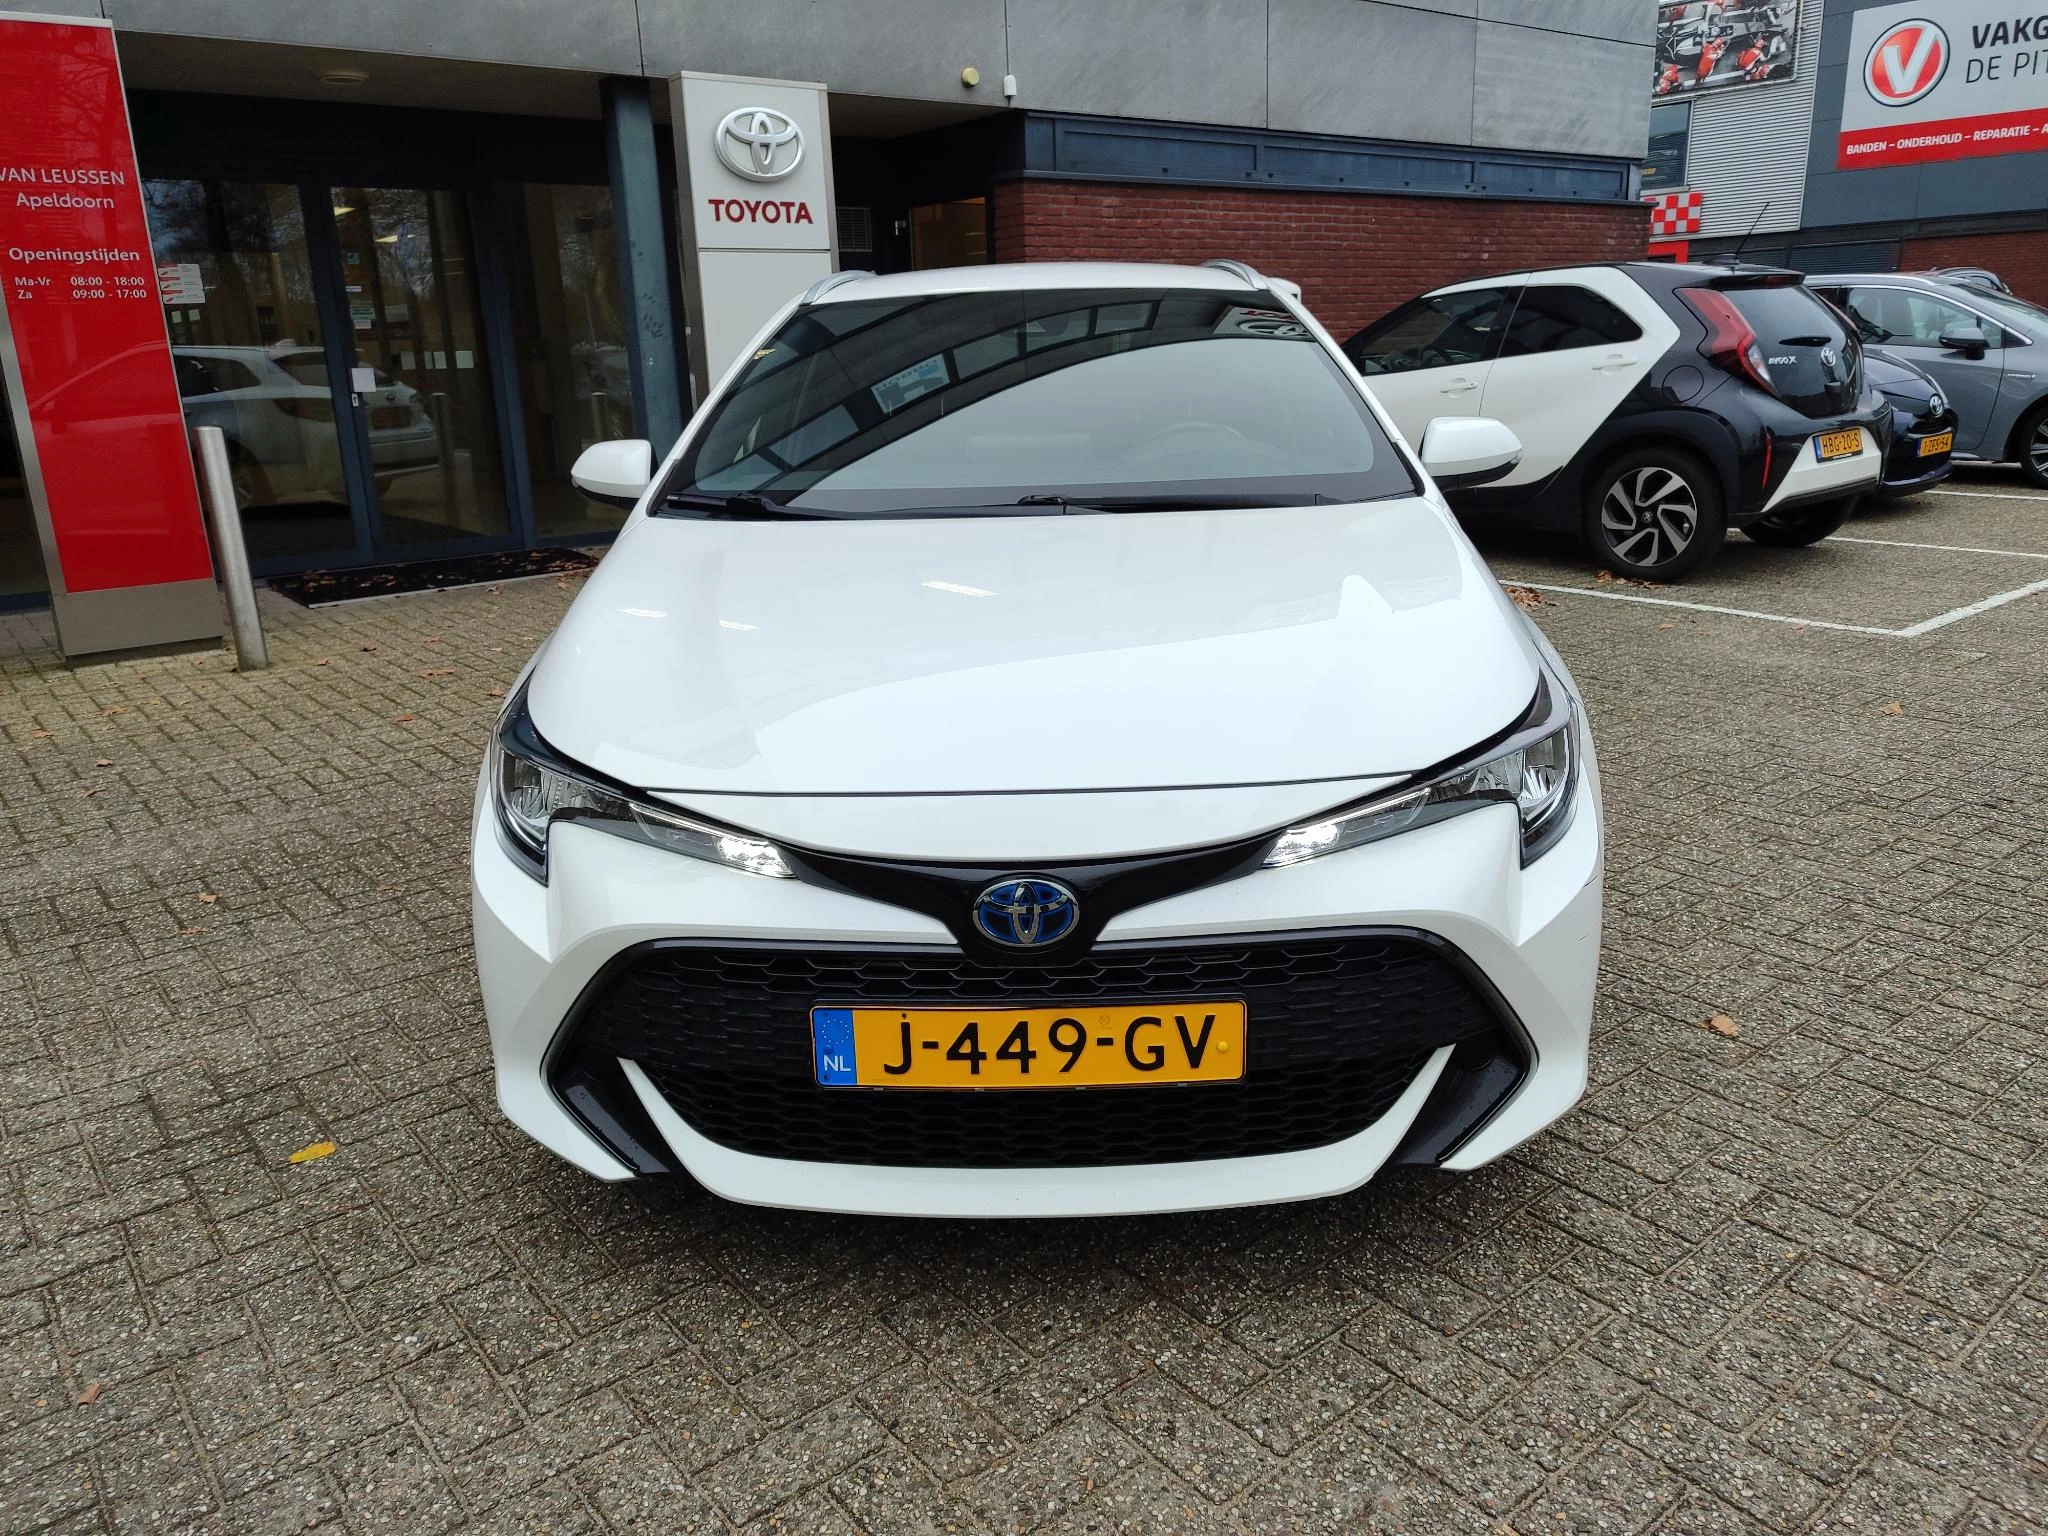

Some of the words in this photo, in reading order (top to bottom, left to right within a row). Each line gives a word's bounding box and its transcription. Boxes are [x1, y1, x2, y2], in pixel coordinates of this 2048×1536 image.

[1966, 56, 2002, 83] DE
[1846, 141, 1887, 155] BANDEN
[1896, 132, 1963, 149] ONDERHOUD
[1973, 125, 2031, 141] REPARATIE
[41, 168, 125, 185] LEUSSEN
[16, 192, 115, 210] Apeldoorn
[708, 199, 813, 224] TOYOTA
[8, 247, 140, 264] Openingstijden
[15, 276, 50, 286] Ma-Vr
[71, 276, 103, 286] 08:00
[114, 276, 145, 286] 18:00
[17, 289, 33, 299] Za
[73, 289, 105, 299] 09:00
[116, 289, 147, 299] 17:00
[1822, 432, 1860, 455] HBG-20-S
[883, 1015, 1216, 1075] J-449-GV
[823, 1055, 851, 1072] NL
